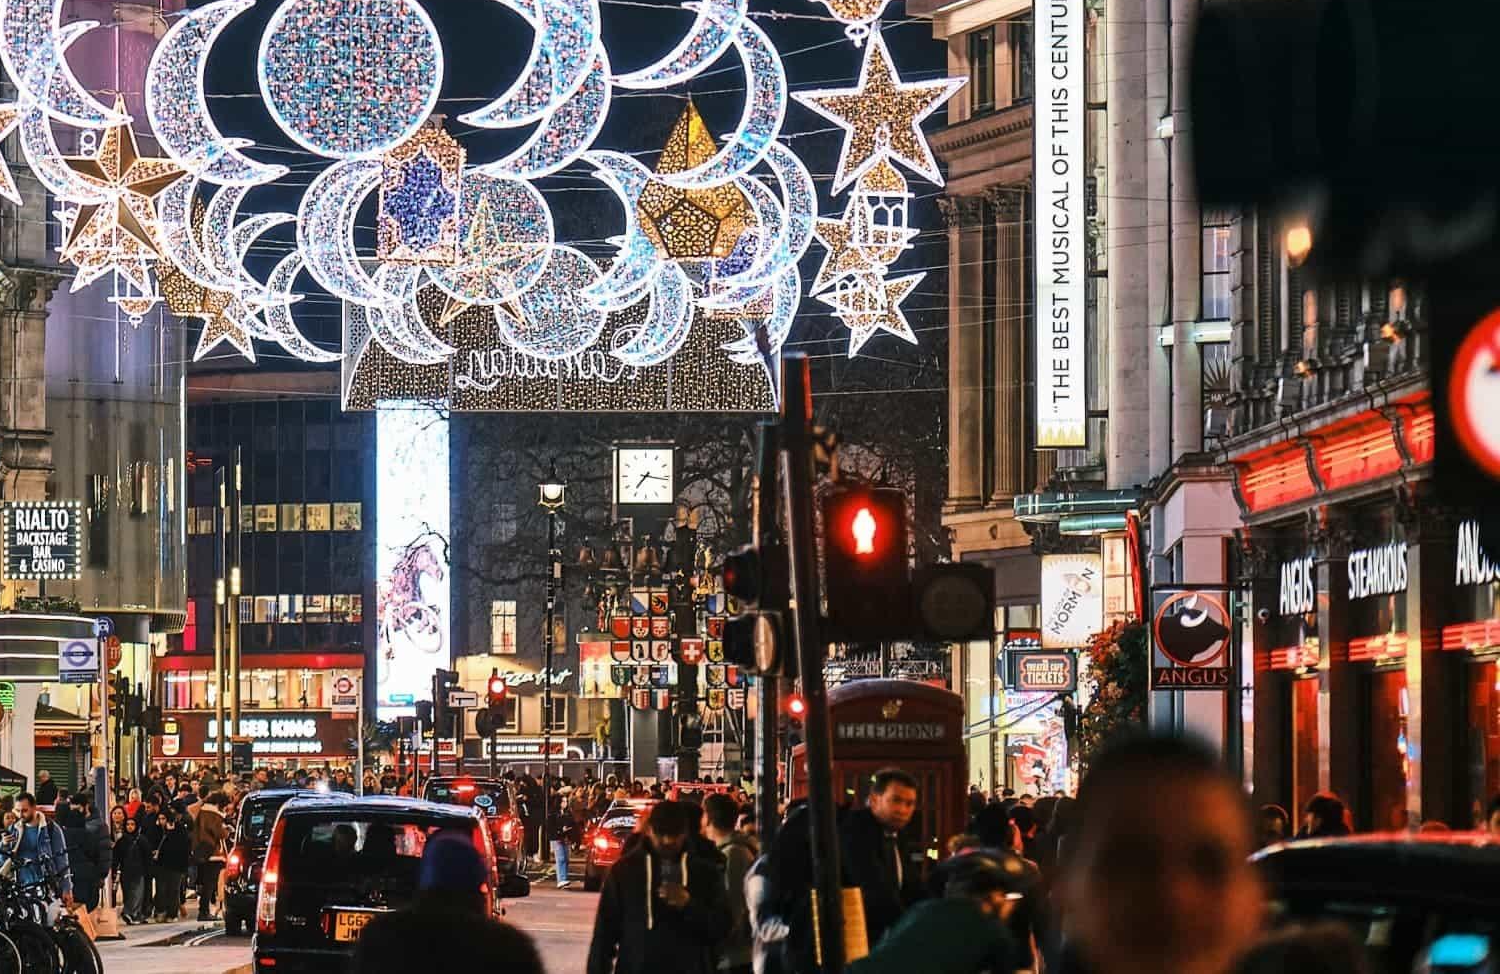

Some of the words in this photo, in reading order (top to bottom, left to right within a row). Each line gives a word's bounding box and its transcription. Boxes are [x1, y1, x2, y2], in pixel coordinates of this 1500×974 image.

[1052, 86, 1070, 138] THIS
[1052, 143, 1070, 176] OF
[1052, 181, 1070, 285] MUSICAL
[1052, 292, 1070, 350] BEST
[15, 508, 69, 531] RIALTO
[16, 531, 69, 546] BACKSTAGE
[32, 545, 52, 559] BAR
[19, 558, 28, 573] &
[31, 558, 66, 573] CASINO
[1280, 556, 1314, 616] ANGUS
[1027, 672, 1065, 684] TICKETS
[1159, 669, 1229, 685] ANGUS
[270, 719, 317, 738] KING
[838, 723, 945, 739] TELEPHONE
